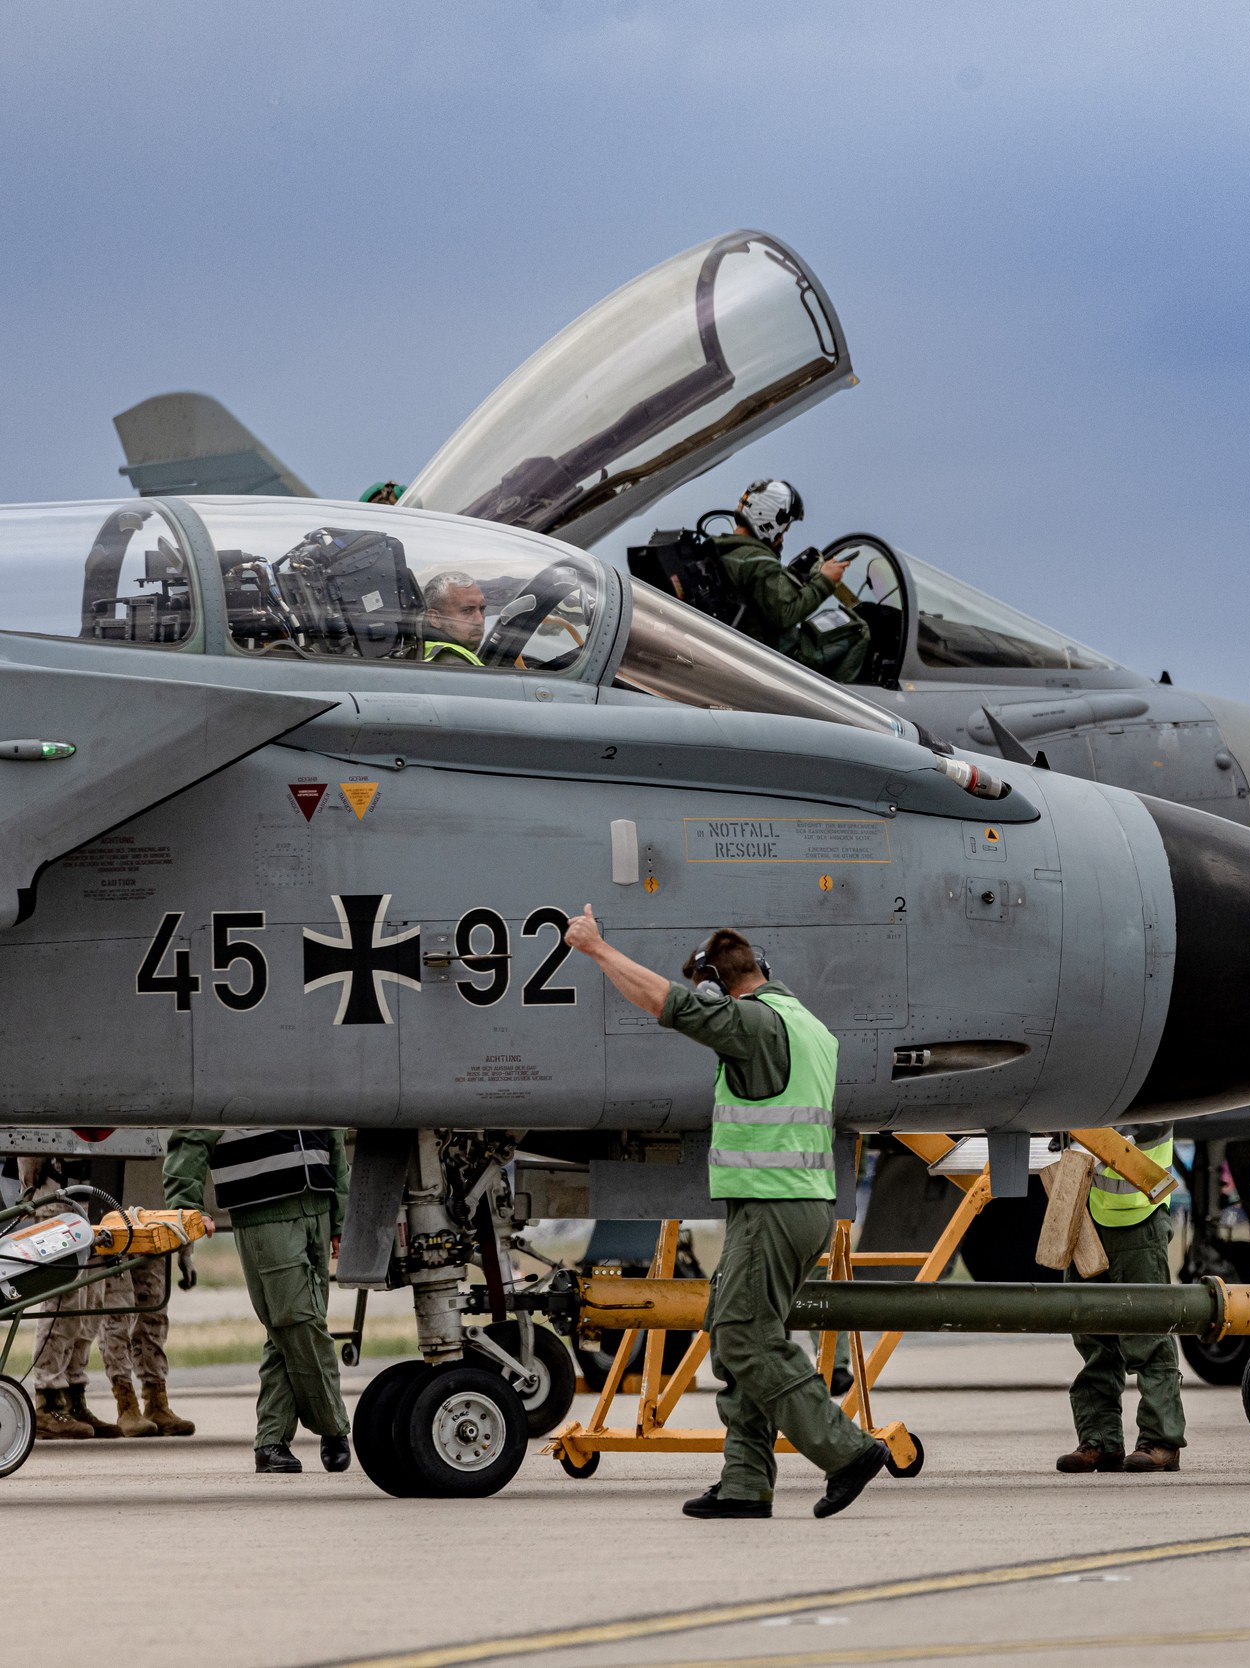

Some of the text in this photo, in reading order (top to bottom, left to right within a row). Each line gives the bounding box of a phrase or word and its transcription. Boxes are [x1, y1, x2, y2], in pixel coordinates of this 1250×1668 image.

[601, 745, 617, 760] 2
[709, 822, 780, 838] NOTFALL
[715, 842, 778, 858] RESCUE
[101, 879, 136, 887] CAUTION
[894, 896, 907, 913] 2
[136, 905, 577, 1013] 45 92
[485, 1054, 522, 1063] ACHTUNG
[795, 1300, 829, 1309] 2-7-11
